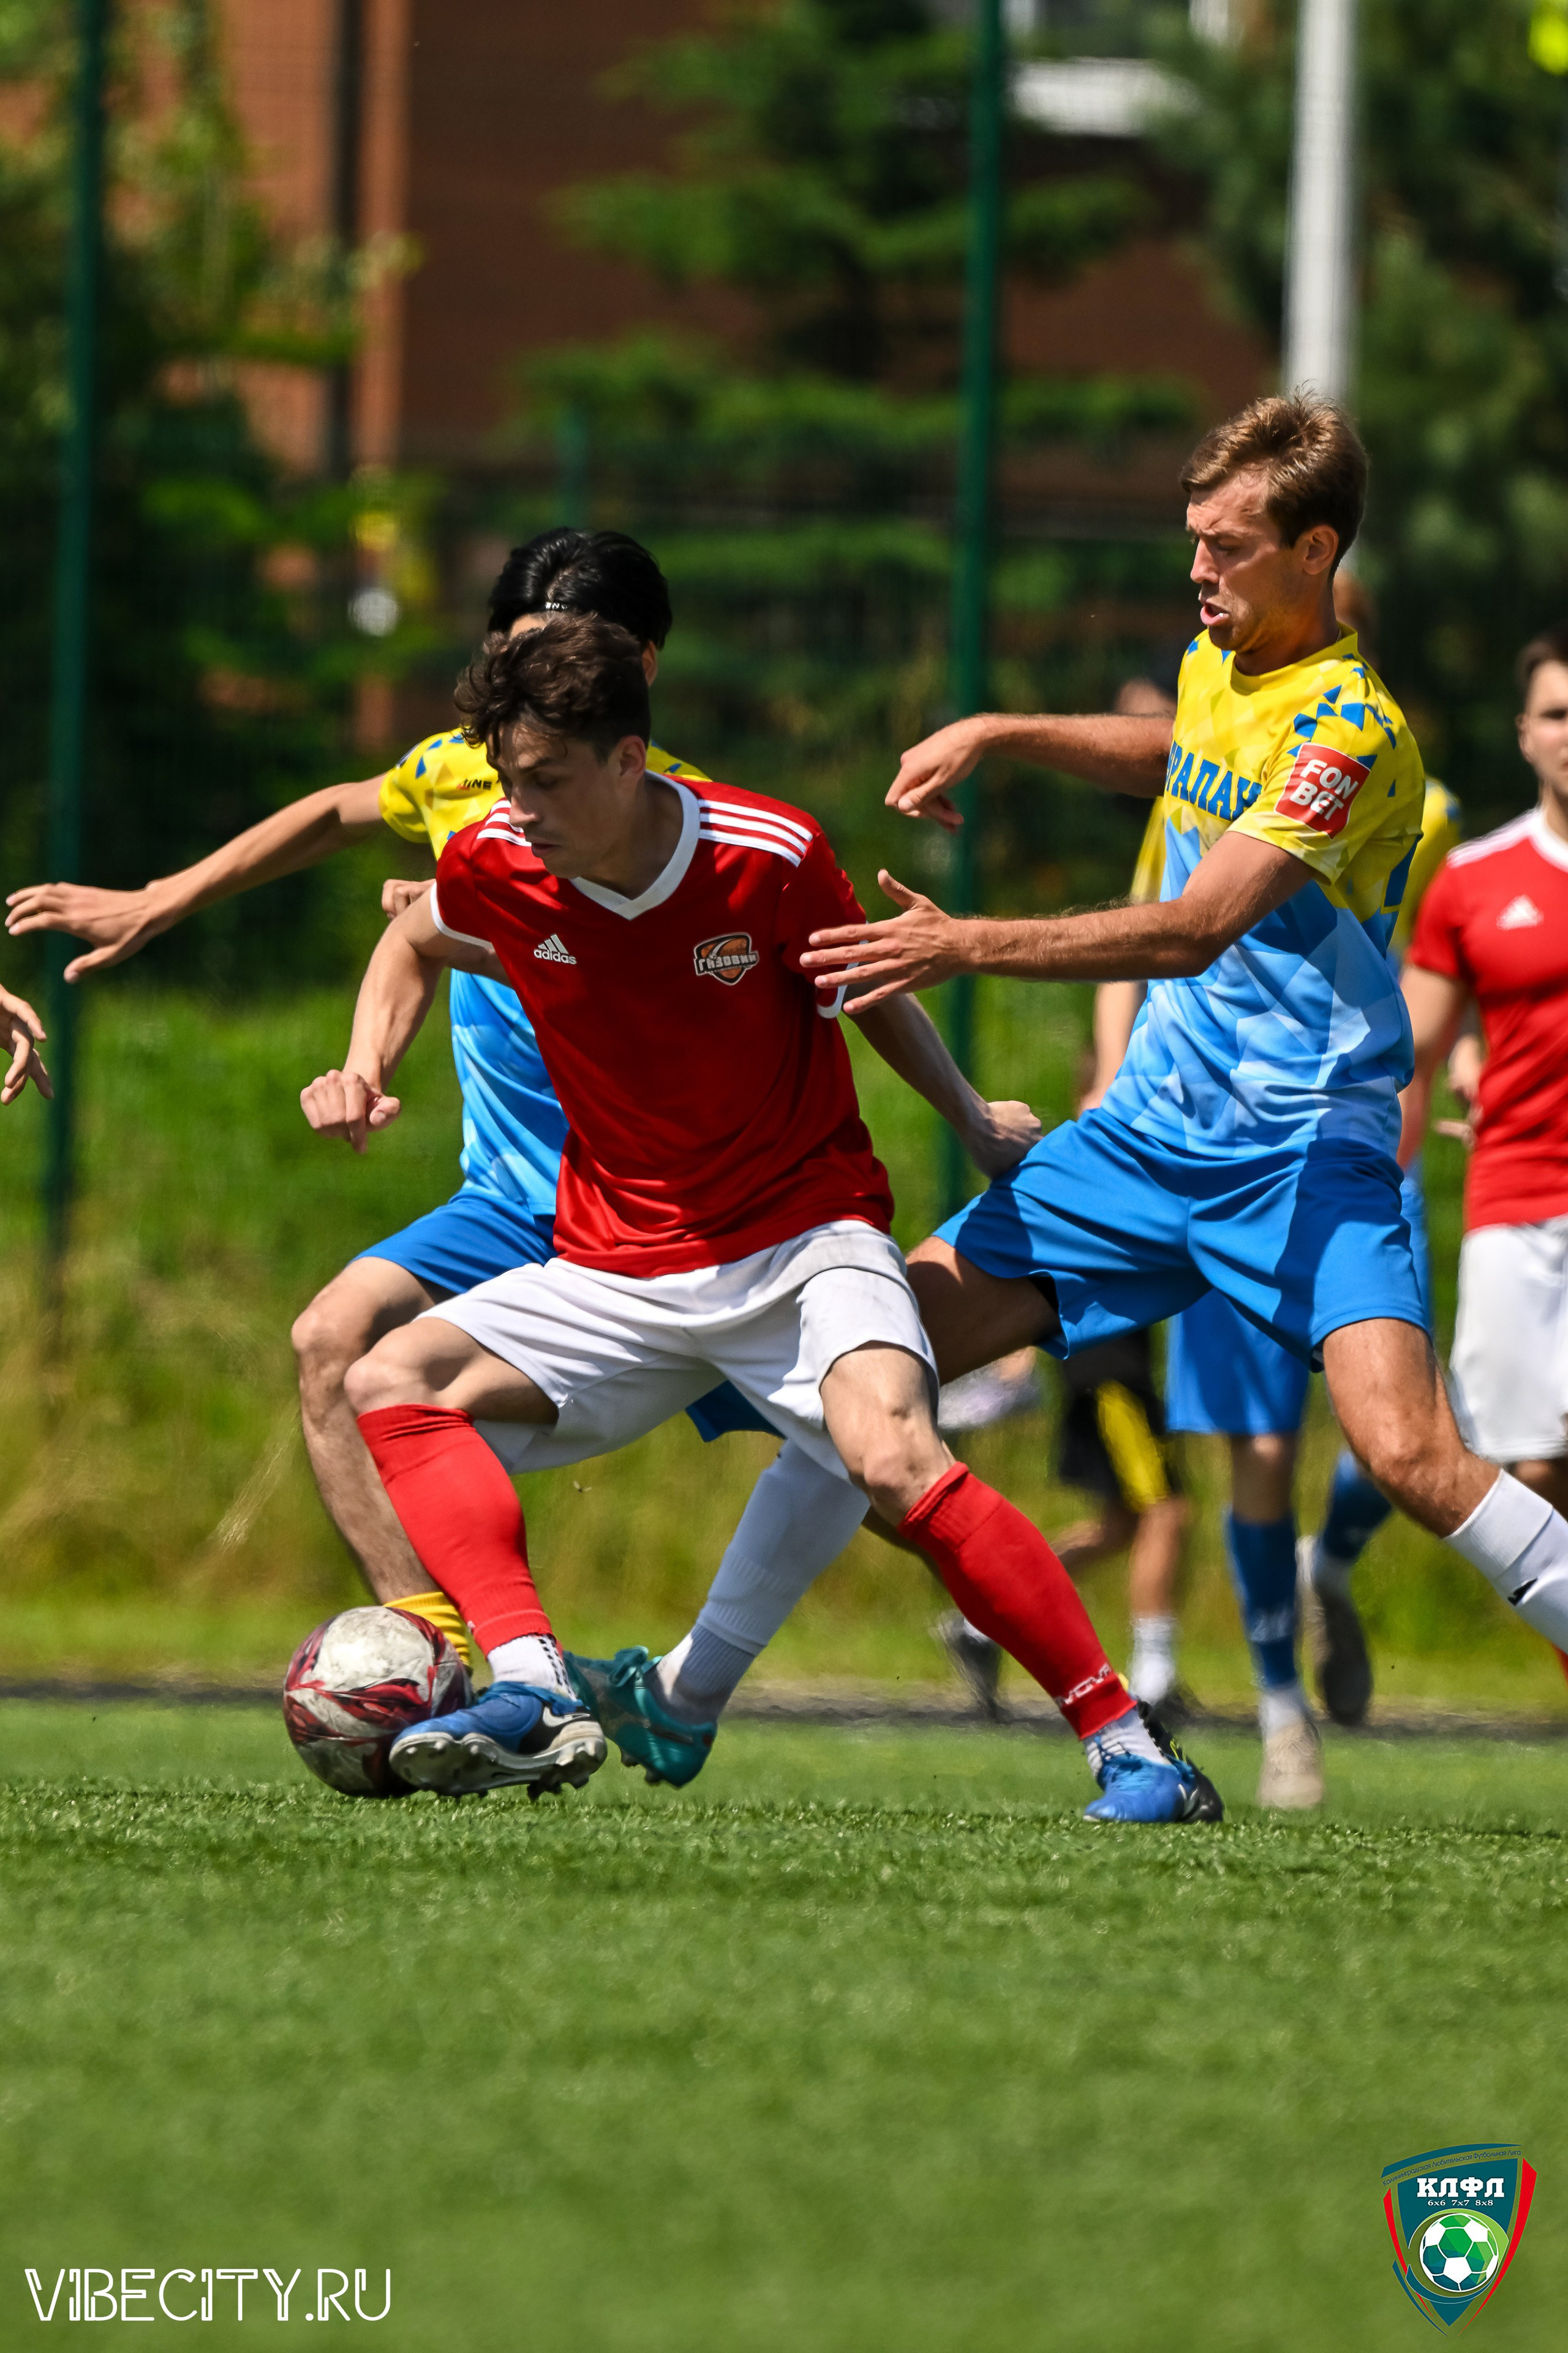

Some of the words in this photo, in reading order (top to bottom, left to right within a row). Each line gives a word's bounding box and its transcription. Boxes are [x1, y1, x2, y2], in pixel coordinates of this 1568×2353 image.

[1300, 759, 1359, 799] FON
[1290, 780, 1344, 820] BET
[533, 949, 577, 965] adidas
